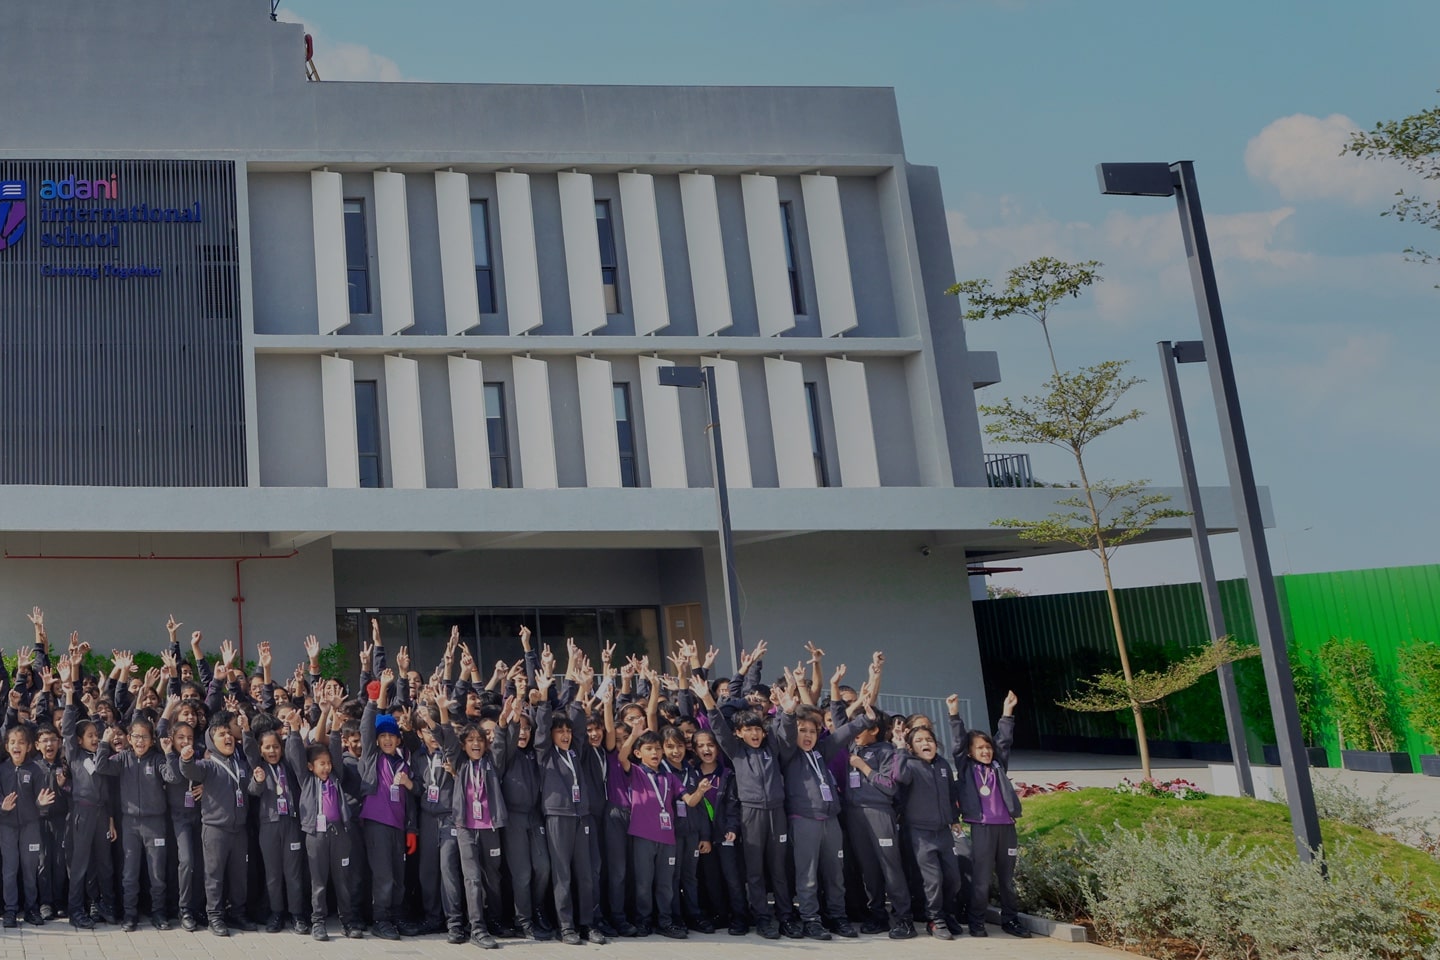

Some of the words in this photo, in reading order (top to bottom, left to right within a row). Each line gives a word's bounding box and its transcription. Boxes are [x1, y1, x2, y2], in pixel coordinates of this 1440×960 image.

[40, 173, 117, 199] adani
[40, 201, 201, 223] international
[40, 226, 120, 248] school
[40, 264, 100, 280] Growing
[104, 264, 162, 280] Together
